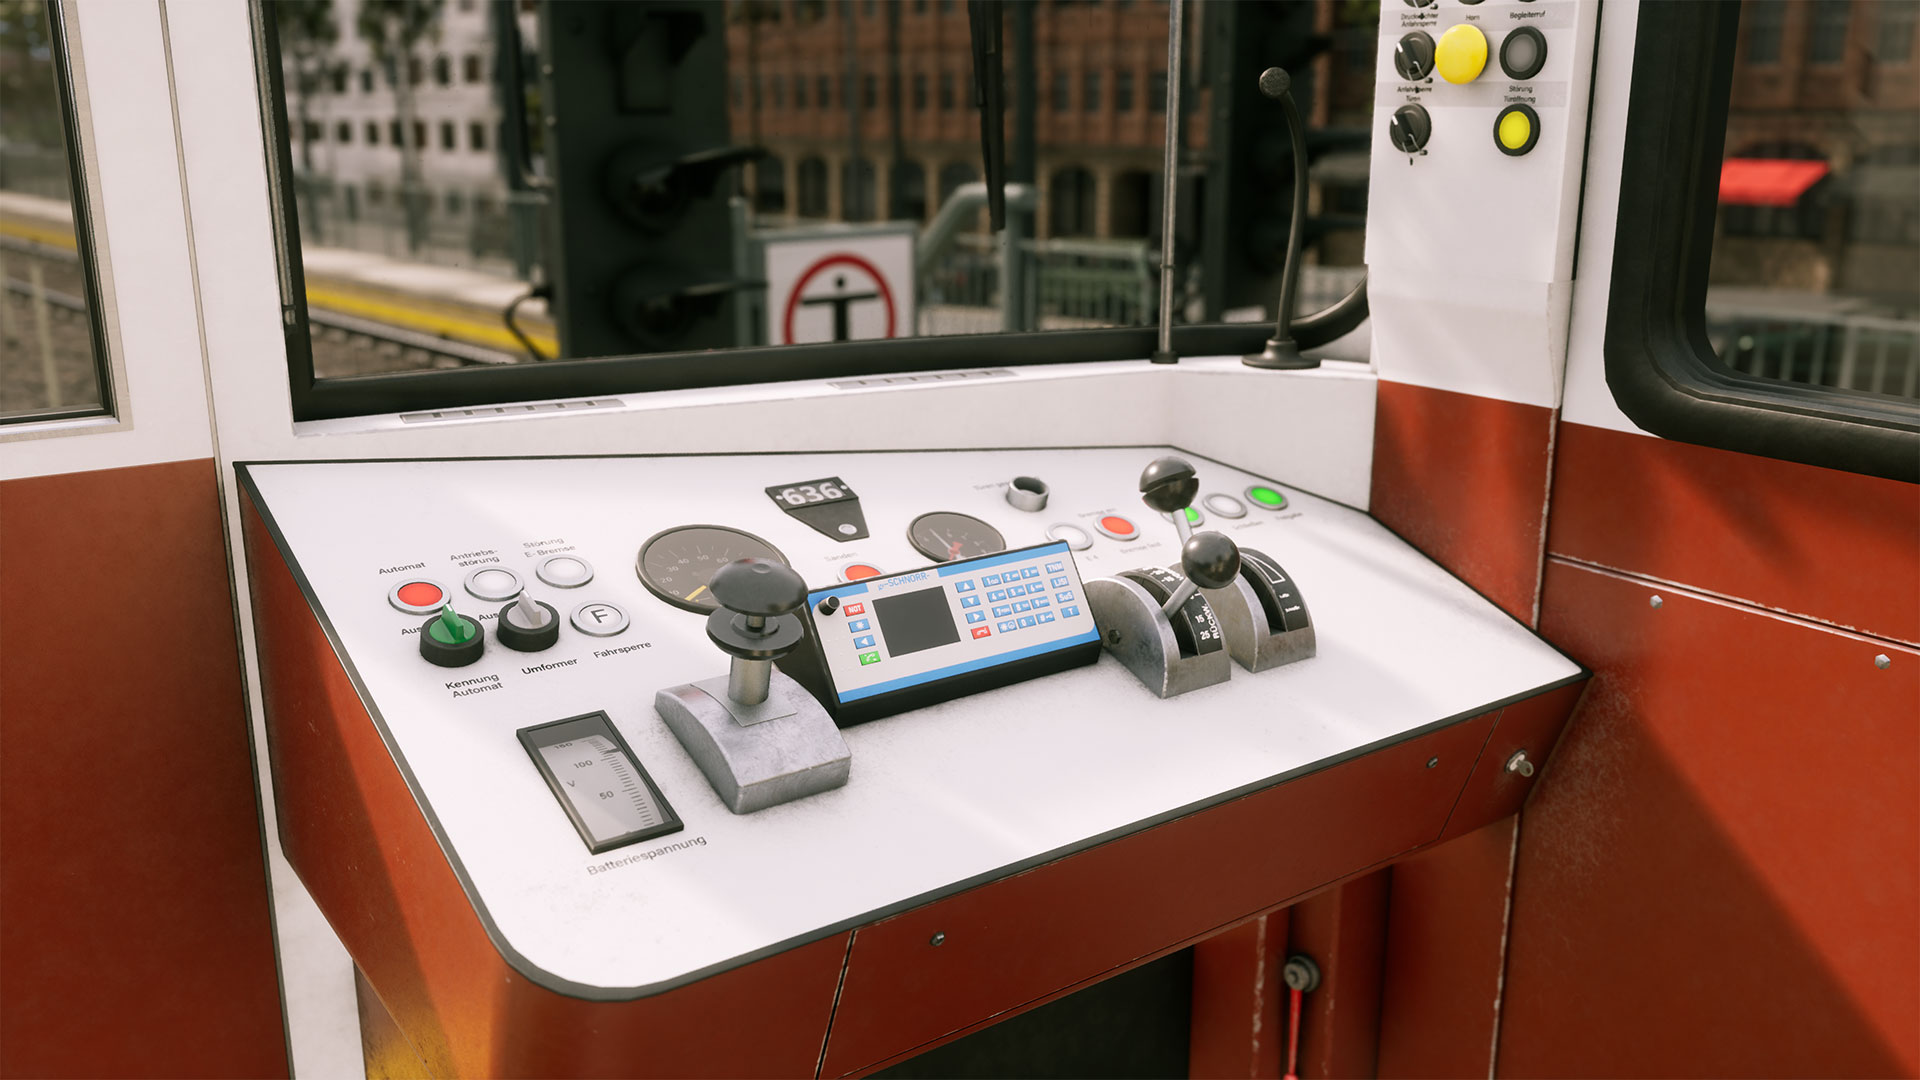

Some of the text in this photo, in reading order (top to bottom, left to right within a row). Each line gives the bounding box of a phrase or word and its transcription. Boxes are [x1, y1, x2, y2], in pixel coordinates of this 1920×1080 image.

[1510, 11, 1545, 20] Begleiterruf
[782, 482, 842, 505] 636
[523, 538, 564, 549] Störung
[450, 549, 498, 561] Antriebs-
[459, 556, 500, 567] störung
[379, 562, 426, 574] Automat
[848, 605, 862, 613] NOT
[591, 609, 608, 623] F
[1200, 630, 1211, 640] 25
[593, 642, 652, 658] Fahrsperre
[521, 658, 578, 675] Umformer
[445, 673, 500, 690] Kennung
[452, 682, 504, 698] Automat
[573, 760, 593, 768] 100
[567, 780, 576, 788] V
[599, 790, 614, 799] 50
[587, 836, 707, 875] Batteriespannung
